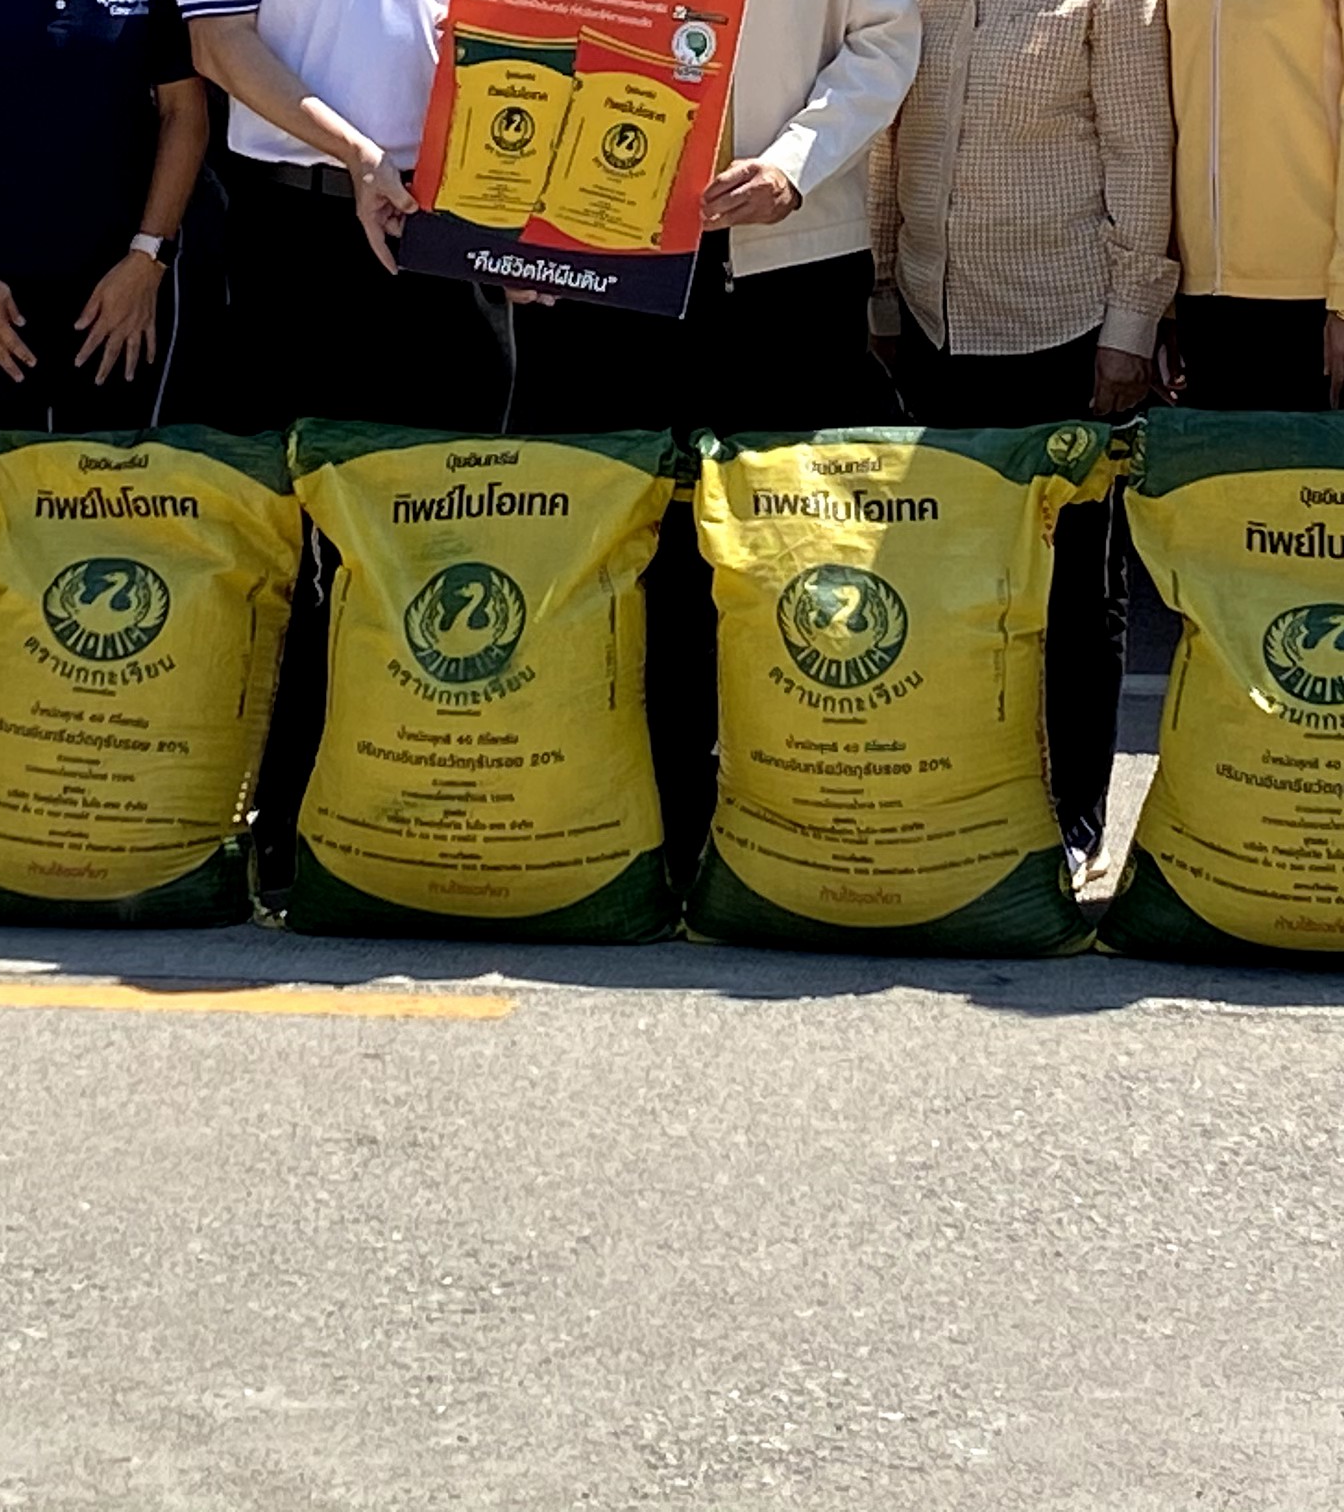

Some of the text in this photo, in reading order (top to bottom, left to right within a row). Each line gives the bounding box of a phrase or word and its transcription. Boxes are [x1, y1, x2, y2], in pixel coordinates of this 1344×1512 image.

[35, 488, 199, 521] ทิพย์ไบโอเทค
[392, 482, 571, 525] ทิพย์ไบโอเทค
[753, 487, 939, 523] ทิพย์ไบโอเทค
[23, 634, 178, 688] ตรานกกะเรียน
[386, 659, 538, 706] ตรานกกะเรียน
[768, 665, 925, 715] ตรานกกะเรียน
[530, 748, 566, 768] 20%
[918, 755, 953, 773] 20%
